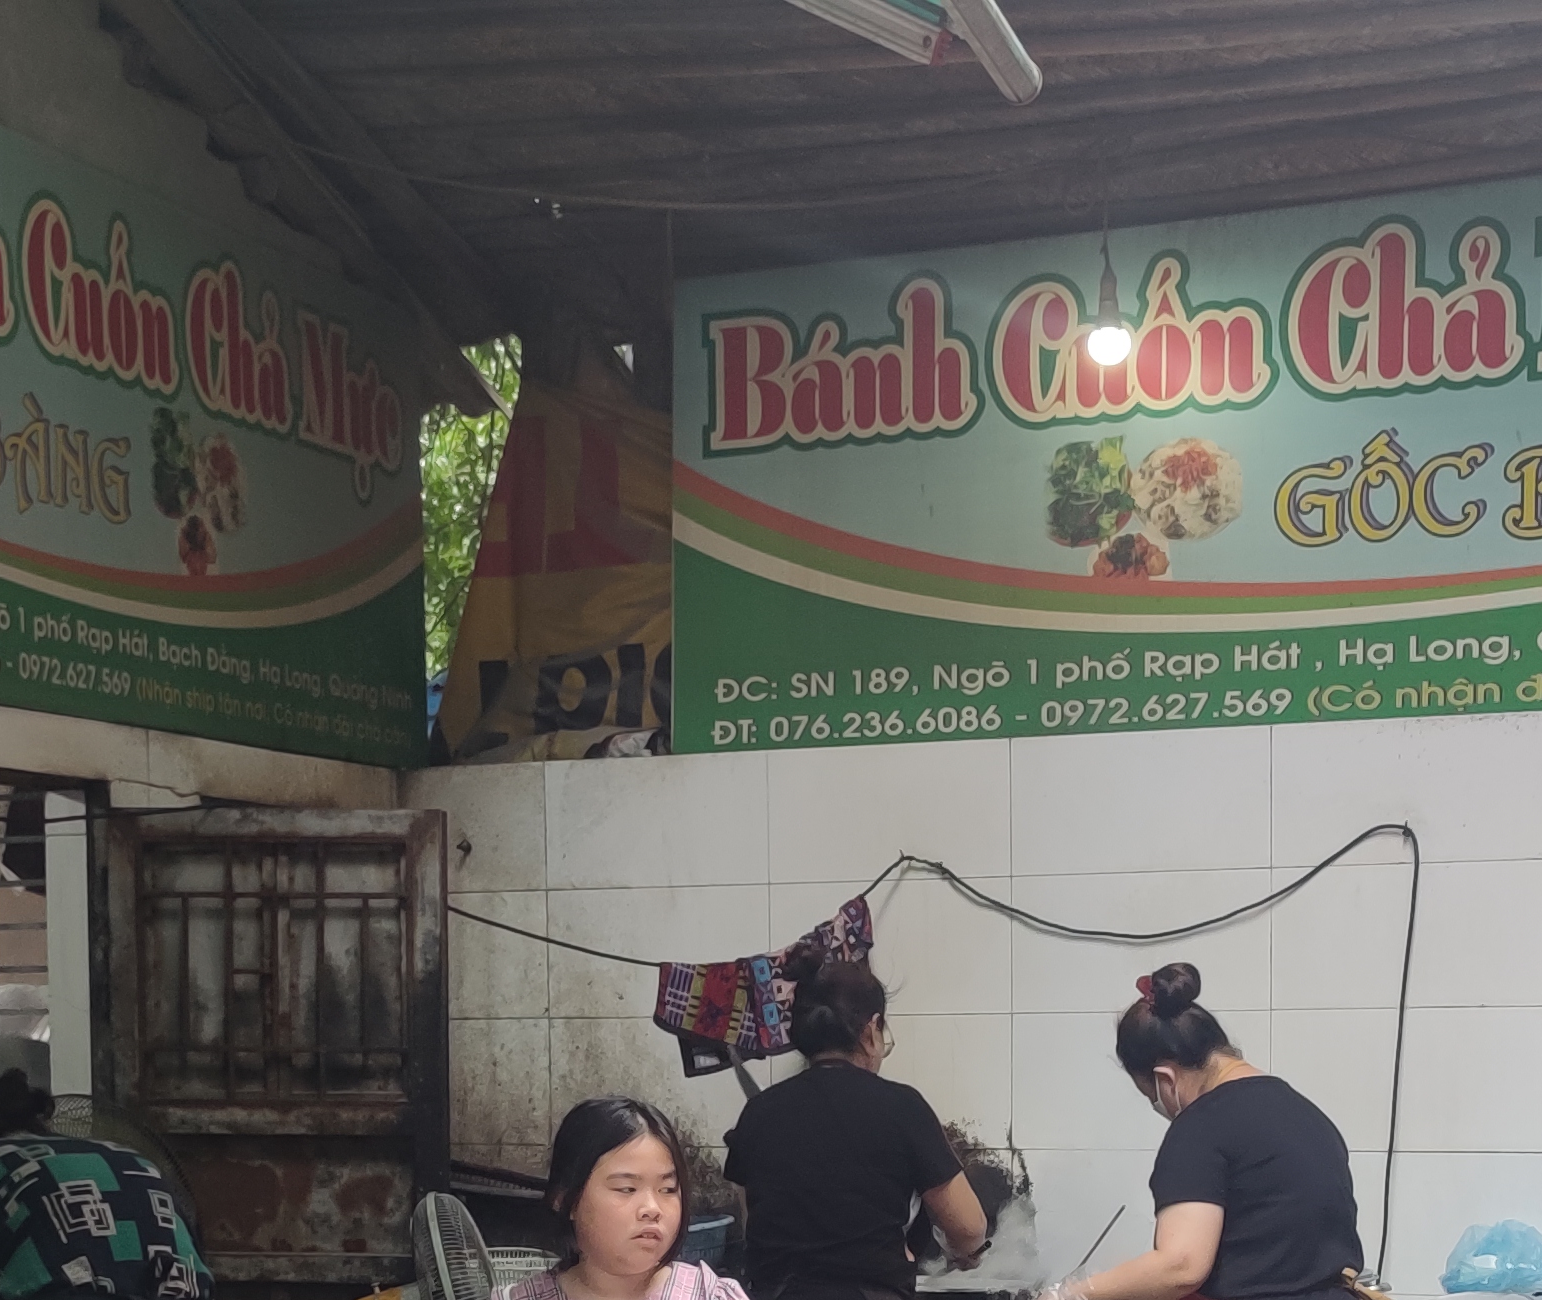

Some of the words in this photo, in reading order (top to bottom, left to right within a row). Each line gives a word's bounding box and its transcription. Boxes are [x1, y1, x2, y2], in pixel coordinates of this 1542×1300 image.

[22, 198, 179, 395] Cuốn
[186, 260, 292, 432] Chả
[297, 308, 402, 501] Mực
[710, 277, 978, 451] Bánh
[994, 257, 1271, 424] Cuốn
[1288, 222, 1525, 392] Chả
[1275, 427, 1495, 548] GỐC
[17, 606, 27, 634] 1
[33, 606, 72, 648] phố
[77, 619, 114, 656] Rạp
[119, 622, 154, 665] Hát,
[159, 635, 202, 673] Bạch
[715, 676, 778, 703] ĐC:
[789, 671, 836, 698] SN
[852, 666, 919, 697] 189,
[933, 660, 1011, 695] Ngõ
[1027, 659, 1038, 685] 1
[1056, 648, 1132, 688] phố
[1143, 650, 1220, 683] Rạp
[1233, 638, 1301, 672] Hát
[1339, 637, 1395, 672] Hạ
[1408, 633, 1521, 666] Long,
[19, 652, 132, 699] 0972.627.569
[136, 675, 184, 714] (Nhận
[711, 718, 757, 745] ĐT:
[769, 704, 1002, 743] 076.236.6086
[1040, 687, 1292, 728] 0972.627.569
[1307, 681, 1381, 717] (Có
[1395, 675, 1502, 713] nhận
